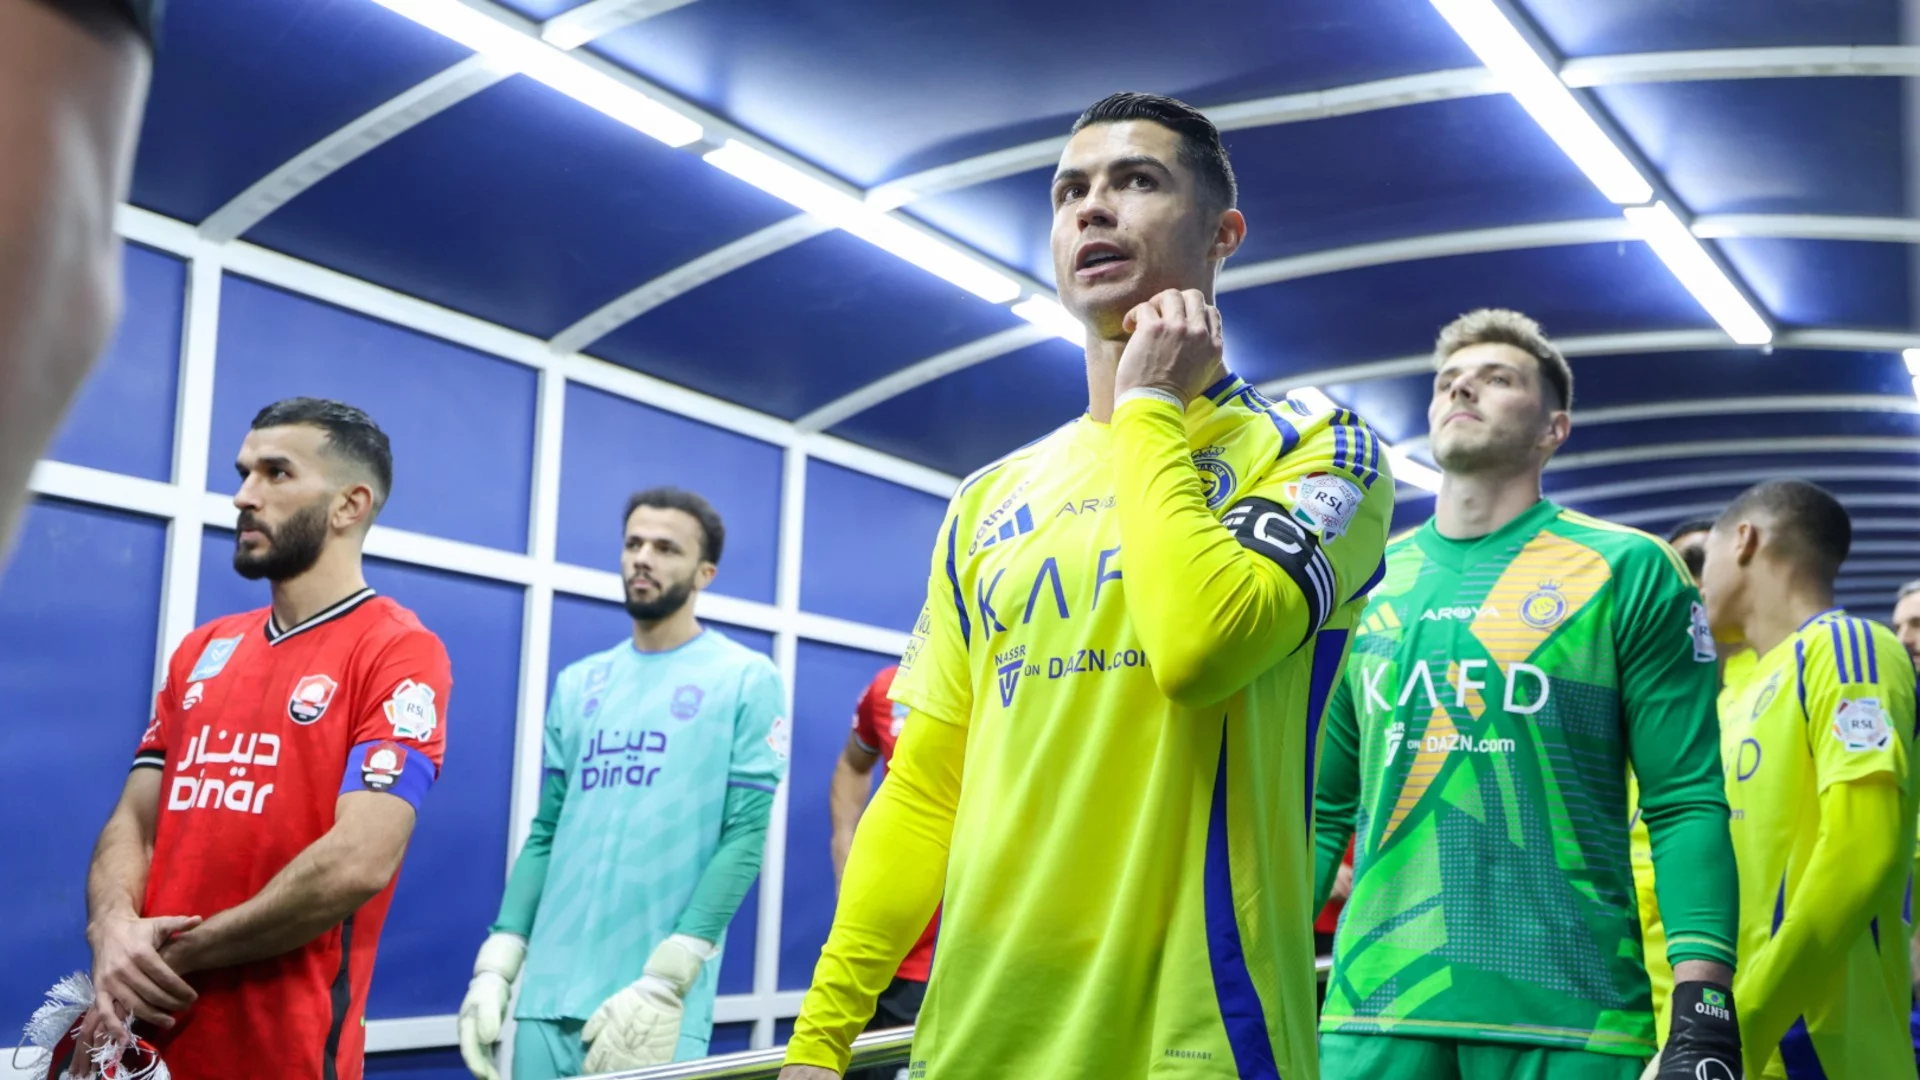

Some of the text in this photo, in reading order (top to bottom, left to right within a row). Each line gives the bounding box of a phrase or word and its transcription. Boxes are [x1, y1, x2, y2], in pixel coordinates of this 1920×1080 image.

[1315, 491, 1343, 516] RSL
[977, 545, 1123, 642] KAF
[994, 644, 1026, 667] NASSR
[1024, 664, 1040, 677] ON
[1362, 658, 1550, 715] KAFD
[406, 703, 425, 718] RSL
[1851, 719, 1873, 730] RSL
[176, 724, 281, 776] دينار
[582, 728, 667, 763] دينار
[1406, 733, 1515, 753] ON DAZN.com
[1694, 1001, 1730, 1022] BENTO
